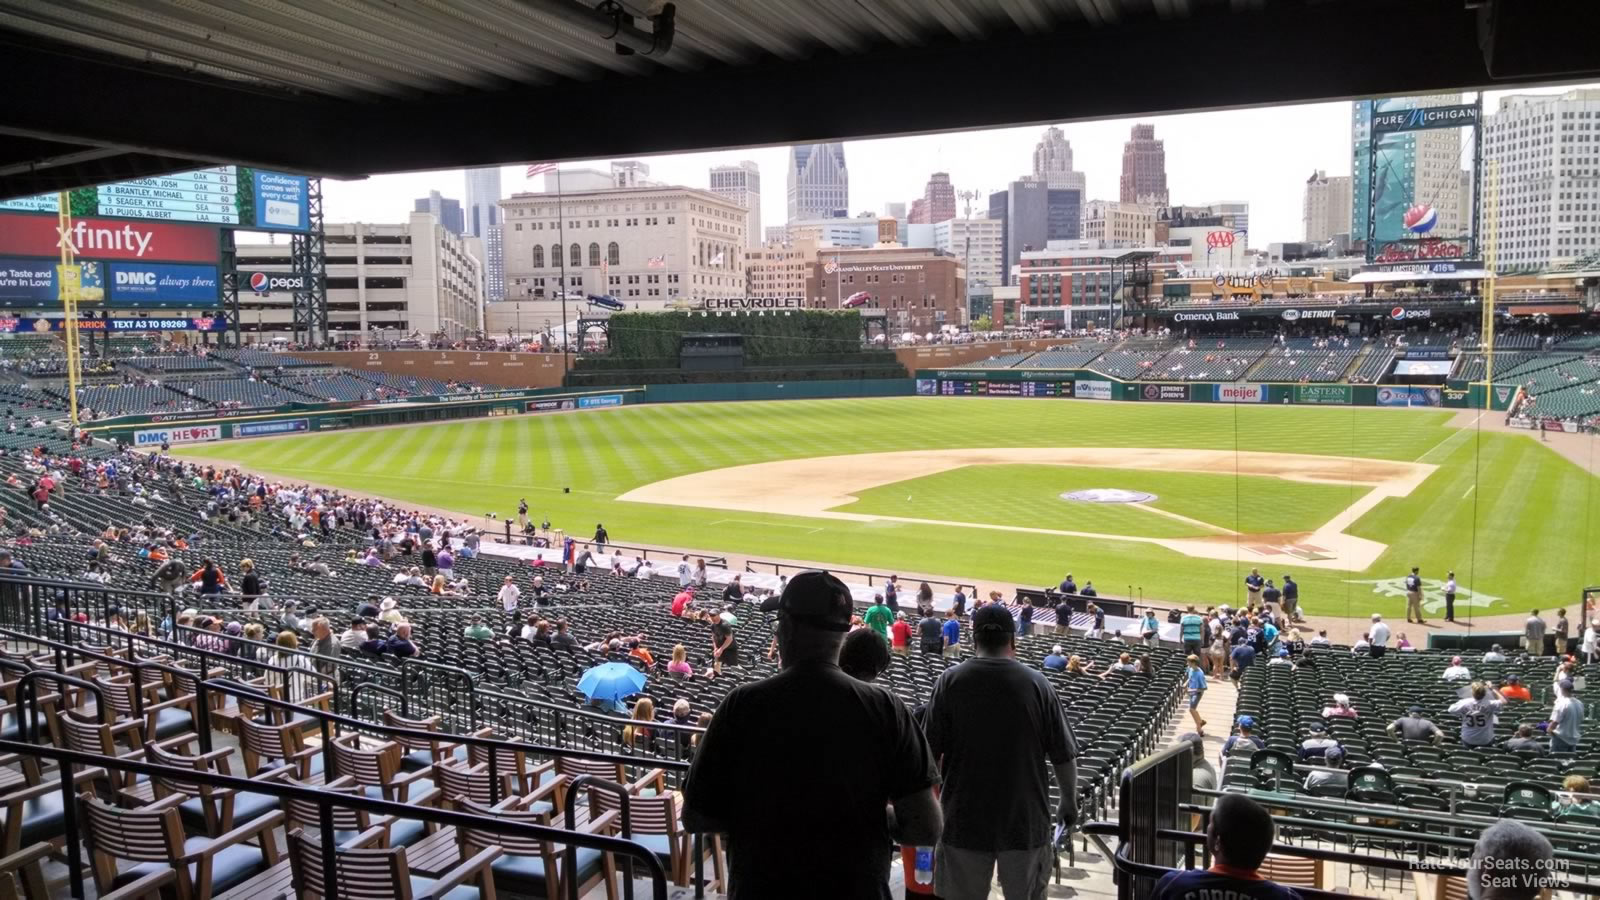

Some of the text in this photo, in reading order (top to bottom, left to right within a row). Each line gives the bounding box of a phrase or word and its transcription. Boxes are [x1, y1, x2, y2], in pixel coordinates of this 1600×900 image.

[1376, 109, 1475, 127] PURE MICHIGAN
[160, 180, 178, 188] JOSH
[260, 174, 300, 186] Confidence
[115, 187, 152, 197] BRANTLEY,
[154, 190, 184, 199] MICHAEL
[261, 184, 300, 193] comes with
[116, 198, 145, 206] SEAGER,
[117, 208, 144, 216] PUJOLS,
[1209, 232, 1232, 247] AAA
[1433, 264, 1447, 272] 416
[9, 270, 34, 278] Taste
[36, 270, 52, 278] and
[116, 272, 216, 288] DMC always there.
[270, 277, 303, 291] pepsi
[706, 298, 806, 309] CHEVROLET
[1216, 312, 1239, 320] Bank
[1302, 310, 1336, 318] DETROIT
[1406, 309, 1430, 318] pepsi
[1223, 386, 1258, 399] meijer
[1301, 386, 1345, 394] EASTERN
[138, 432, 168, 443] DMC
[1293, 642, 1303, 650] 13
[1466, 714, 1486, 727] 35
